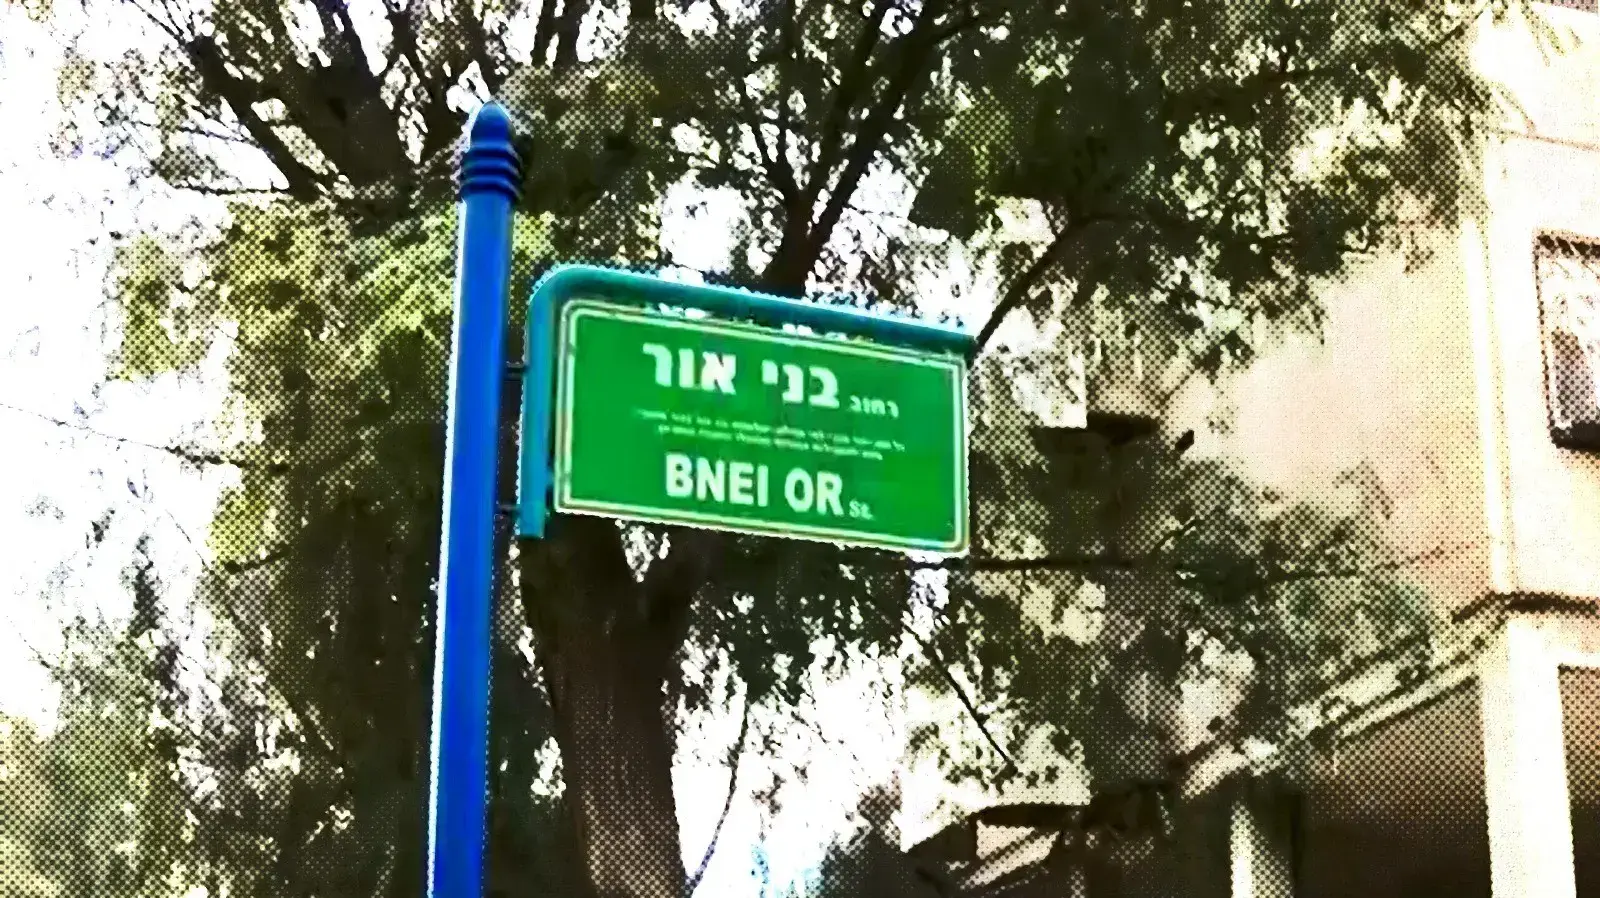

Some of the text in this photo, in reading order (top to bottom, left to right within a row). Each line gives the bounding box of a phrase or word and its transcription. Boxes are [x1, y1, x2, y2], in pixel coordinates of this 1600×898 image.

[642, 342, 900, 419] רחוב בני אור
[665, 451, 769, 507] BNEI
[784, 467, 844, 517] OR
